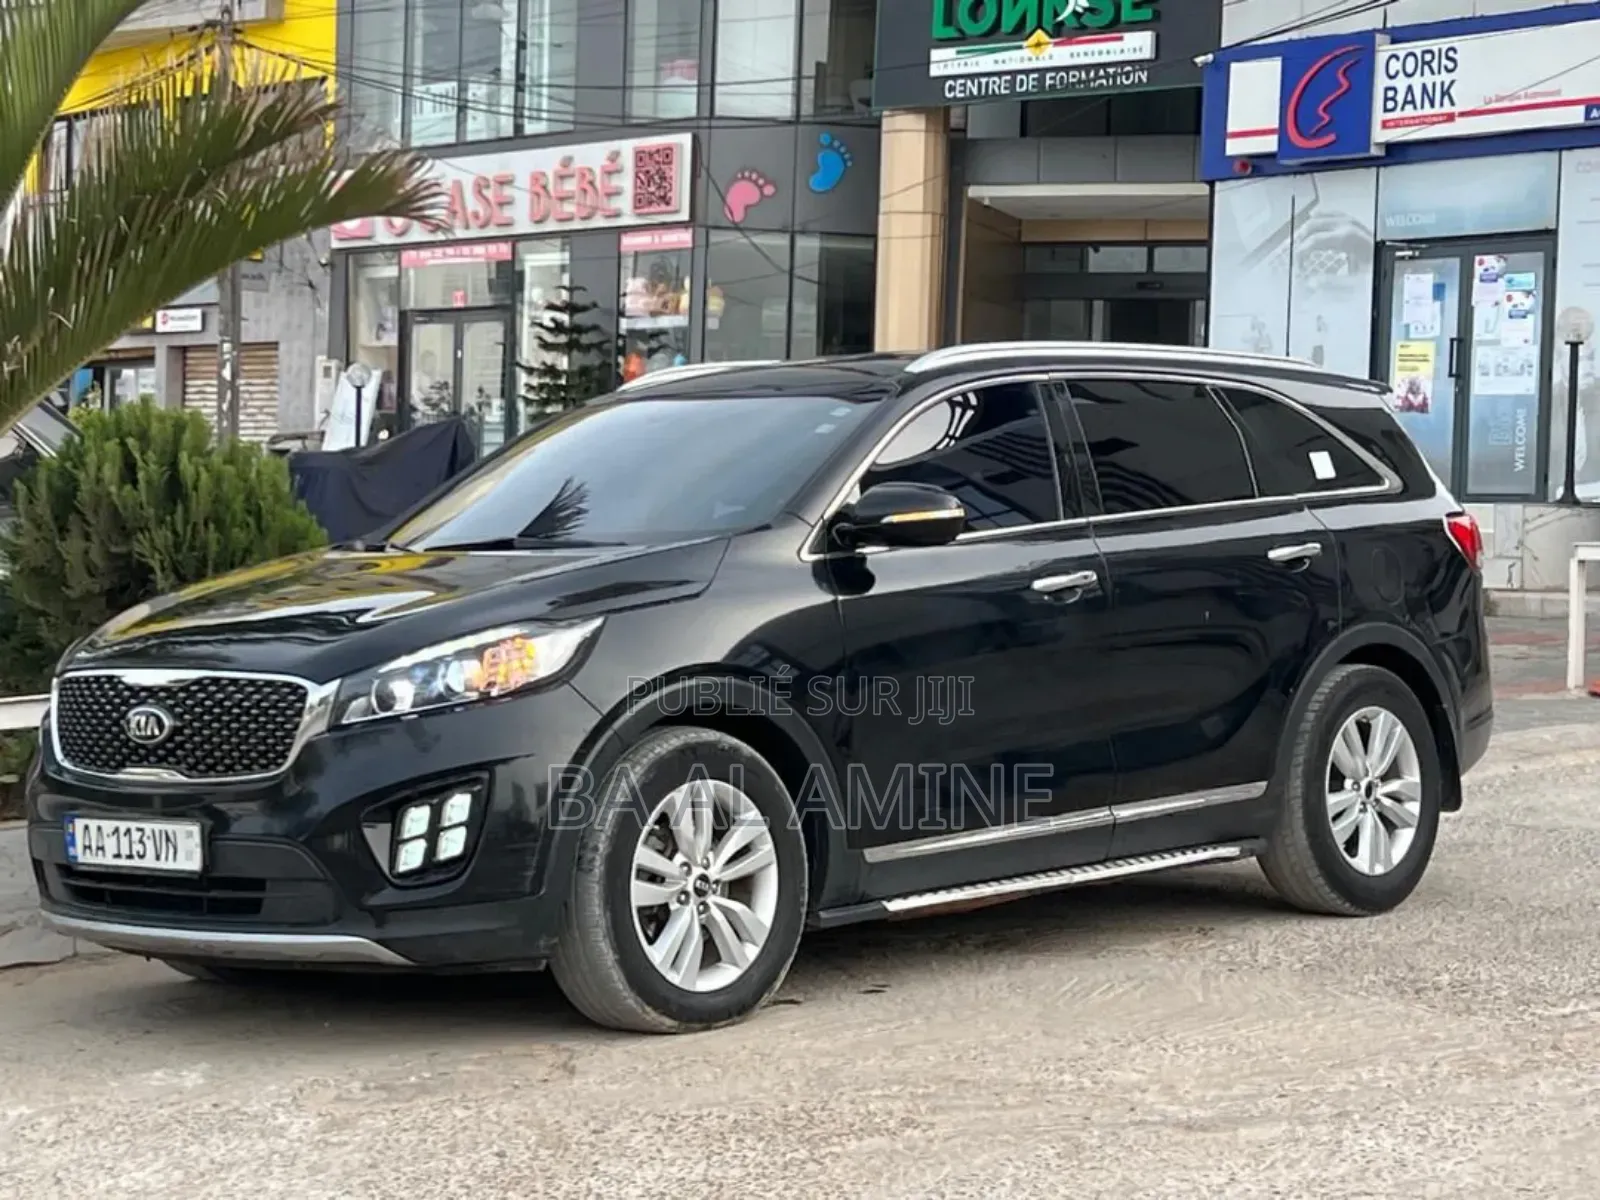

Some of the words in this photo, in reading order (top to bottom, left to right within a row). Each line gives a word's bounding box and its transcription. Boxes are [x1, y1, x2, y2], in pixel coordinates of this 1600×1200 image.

[1385, 46, 1459, 80] CORIS
[943, 75, 1012, 99] CENTRE
[1015, 73, 1039, 94] DE
[1045, 65, 1148, 92] FORMATION
[1382, 80, 1456, 114] BANK
[527, 150, 624, 224] BÉBÉ
[1513, 408, 1527, 473] WELCOME
[128, 714, 161, 737] KIA
